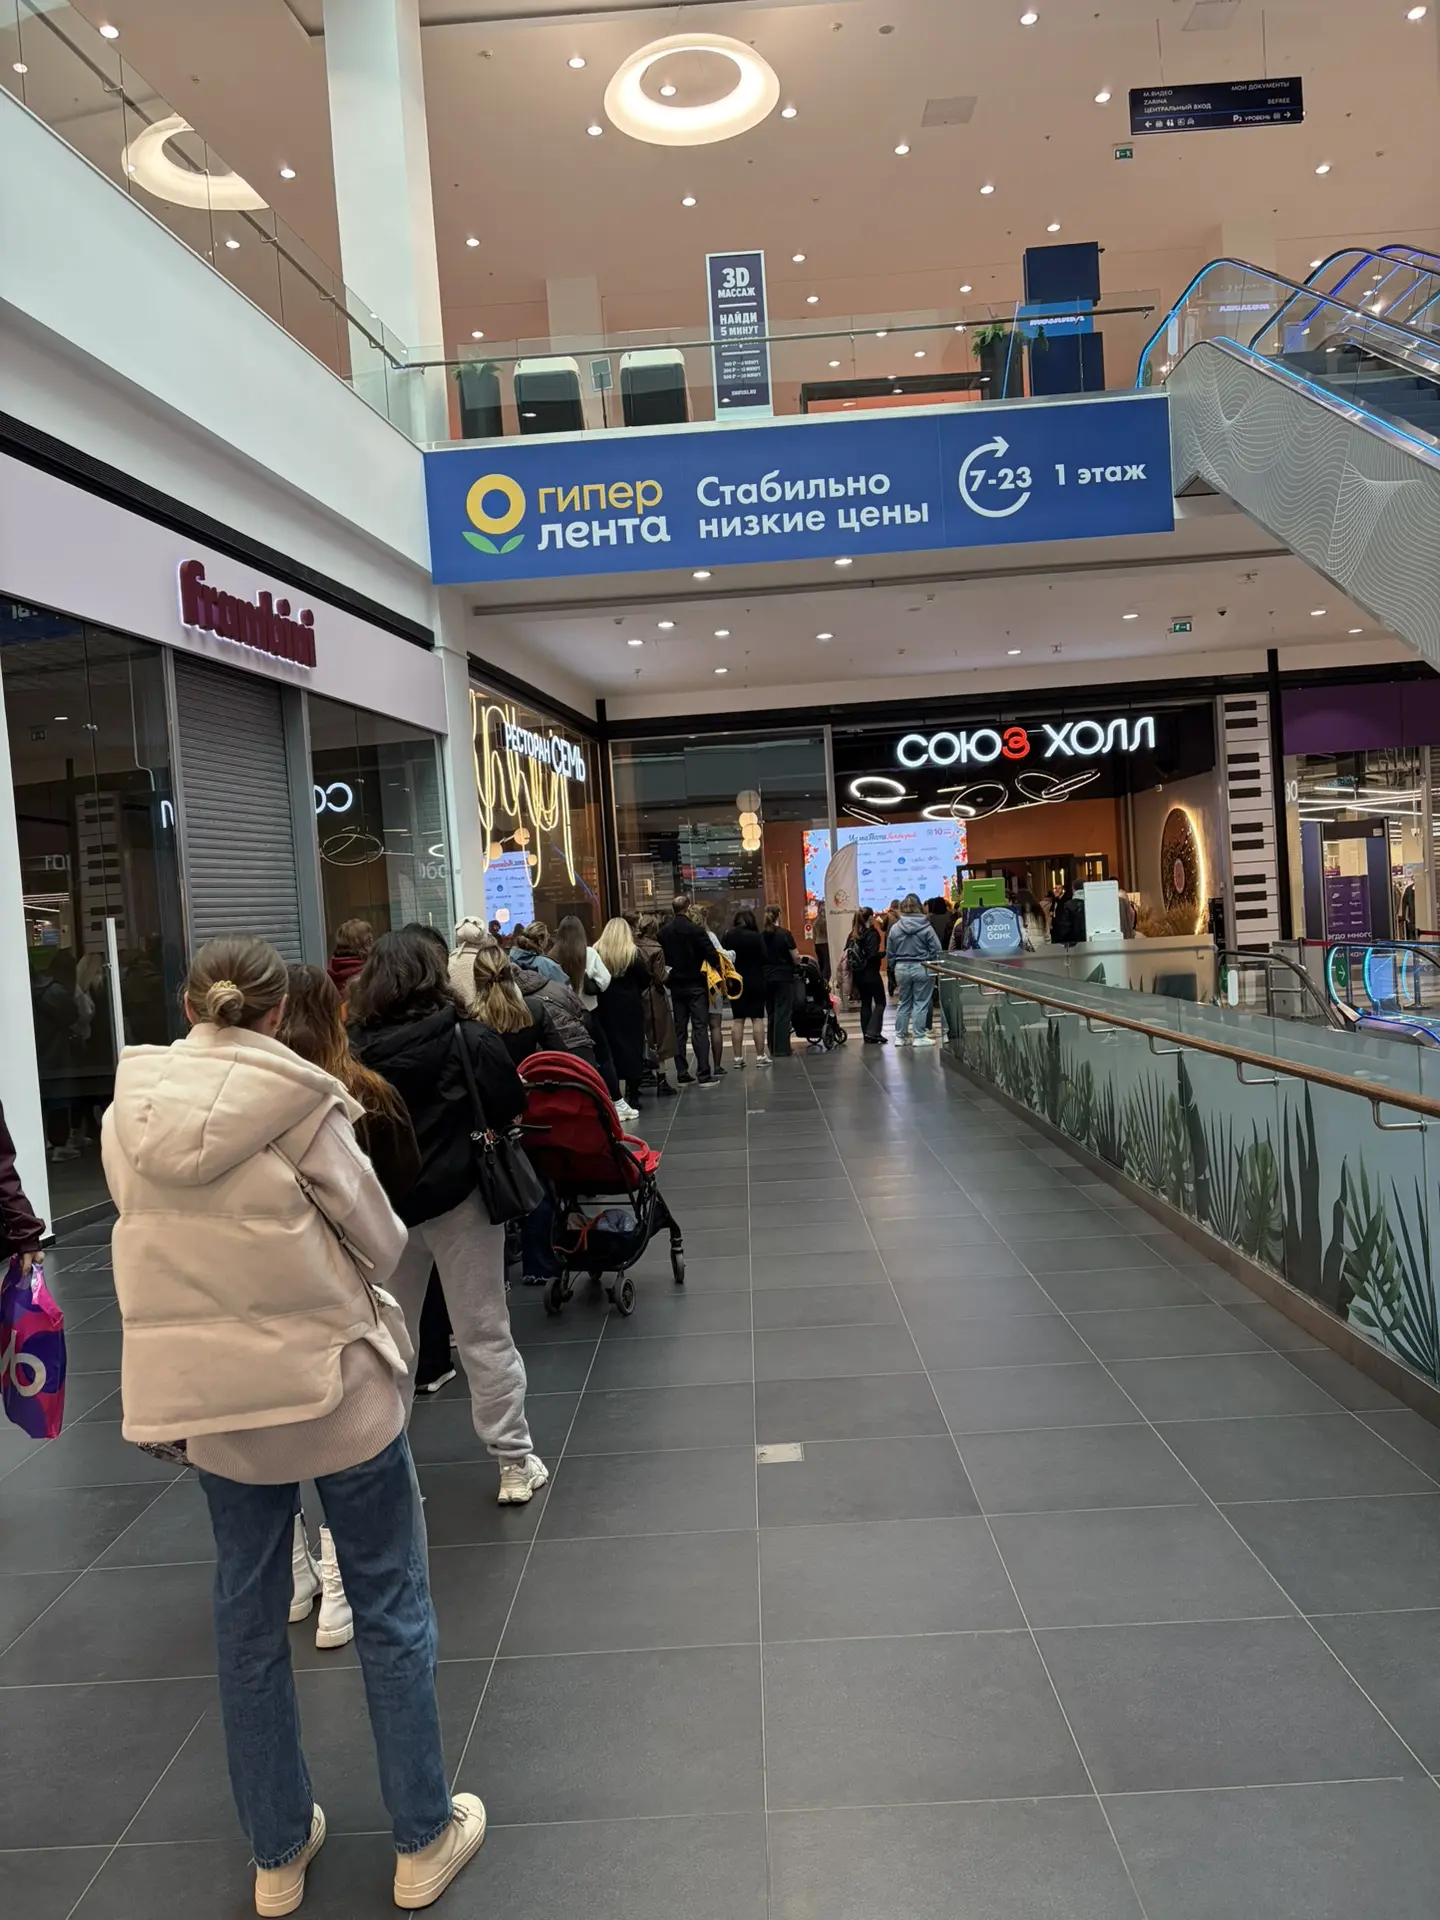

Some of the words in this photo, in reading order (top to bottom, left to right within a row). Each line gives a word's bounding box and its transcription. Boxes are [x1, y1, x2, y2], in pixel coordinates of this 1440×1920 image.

[1248, 81, 1290, 90] ДОКУМЕНТЫ
[1144, 103, 1192, 113] ЦЕНТРАЛЬНЫЙ
[721, 267, 750, 288] 3D
[717, 286, 756, 299] МАССАЖ
[719, 311, 758, 325] НАЙДИ
[720, 326, 727, 336] 5
[728, 325, 759, 335] МИНУТ
[968, 466, 1033, 492] 7-23
[1055, 464, 1066, 486] 1
[1077, 463, 1147, 485] этаж
[538, 479, 664, 515] гипер
[696, 469, 891, 507] Стабильно
[699, 510, 826, 539] низкие
[838, 502, 929, 533] цены
[537, 515, 671, 551] лента
[505, 723, 551, 764] РЕСТОРАН
[551, 735, 586, 782] СЕМЬ
[897, 727, 1030, 767] СОЮЗ
[1042, 716, 1155, 758] ХОЛЛ
[986, 923, 1010, 931] ozon
[987, 931, 1011, 940] банк
